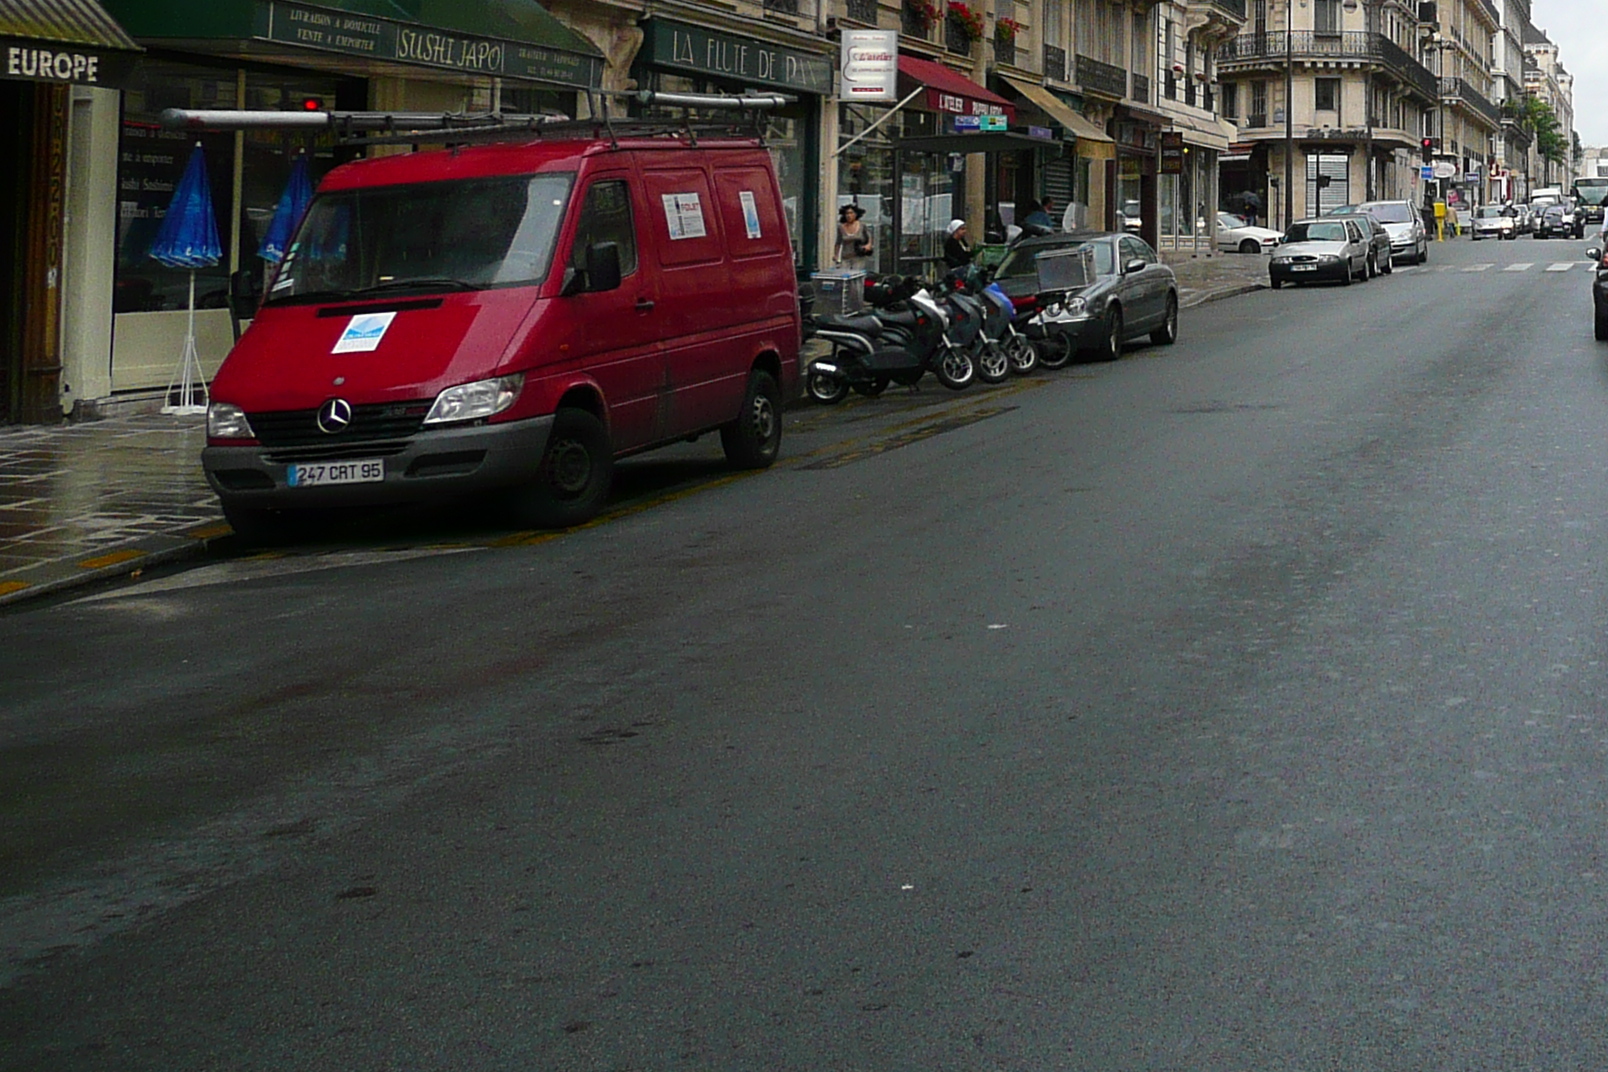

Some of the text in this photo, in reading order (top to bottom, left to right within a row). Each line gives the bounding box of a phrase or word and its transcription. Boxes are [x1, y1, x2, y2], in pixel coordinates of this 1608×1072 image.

[8, 47, 99, 82] EUROPE
[399, 29, 500, 71] SUSHI JAPO
[673, 30, 694, 65] LA
[758, 49, 776, 81] DE
[297, 463, 382, 482] 247 CRT 95
